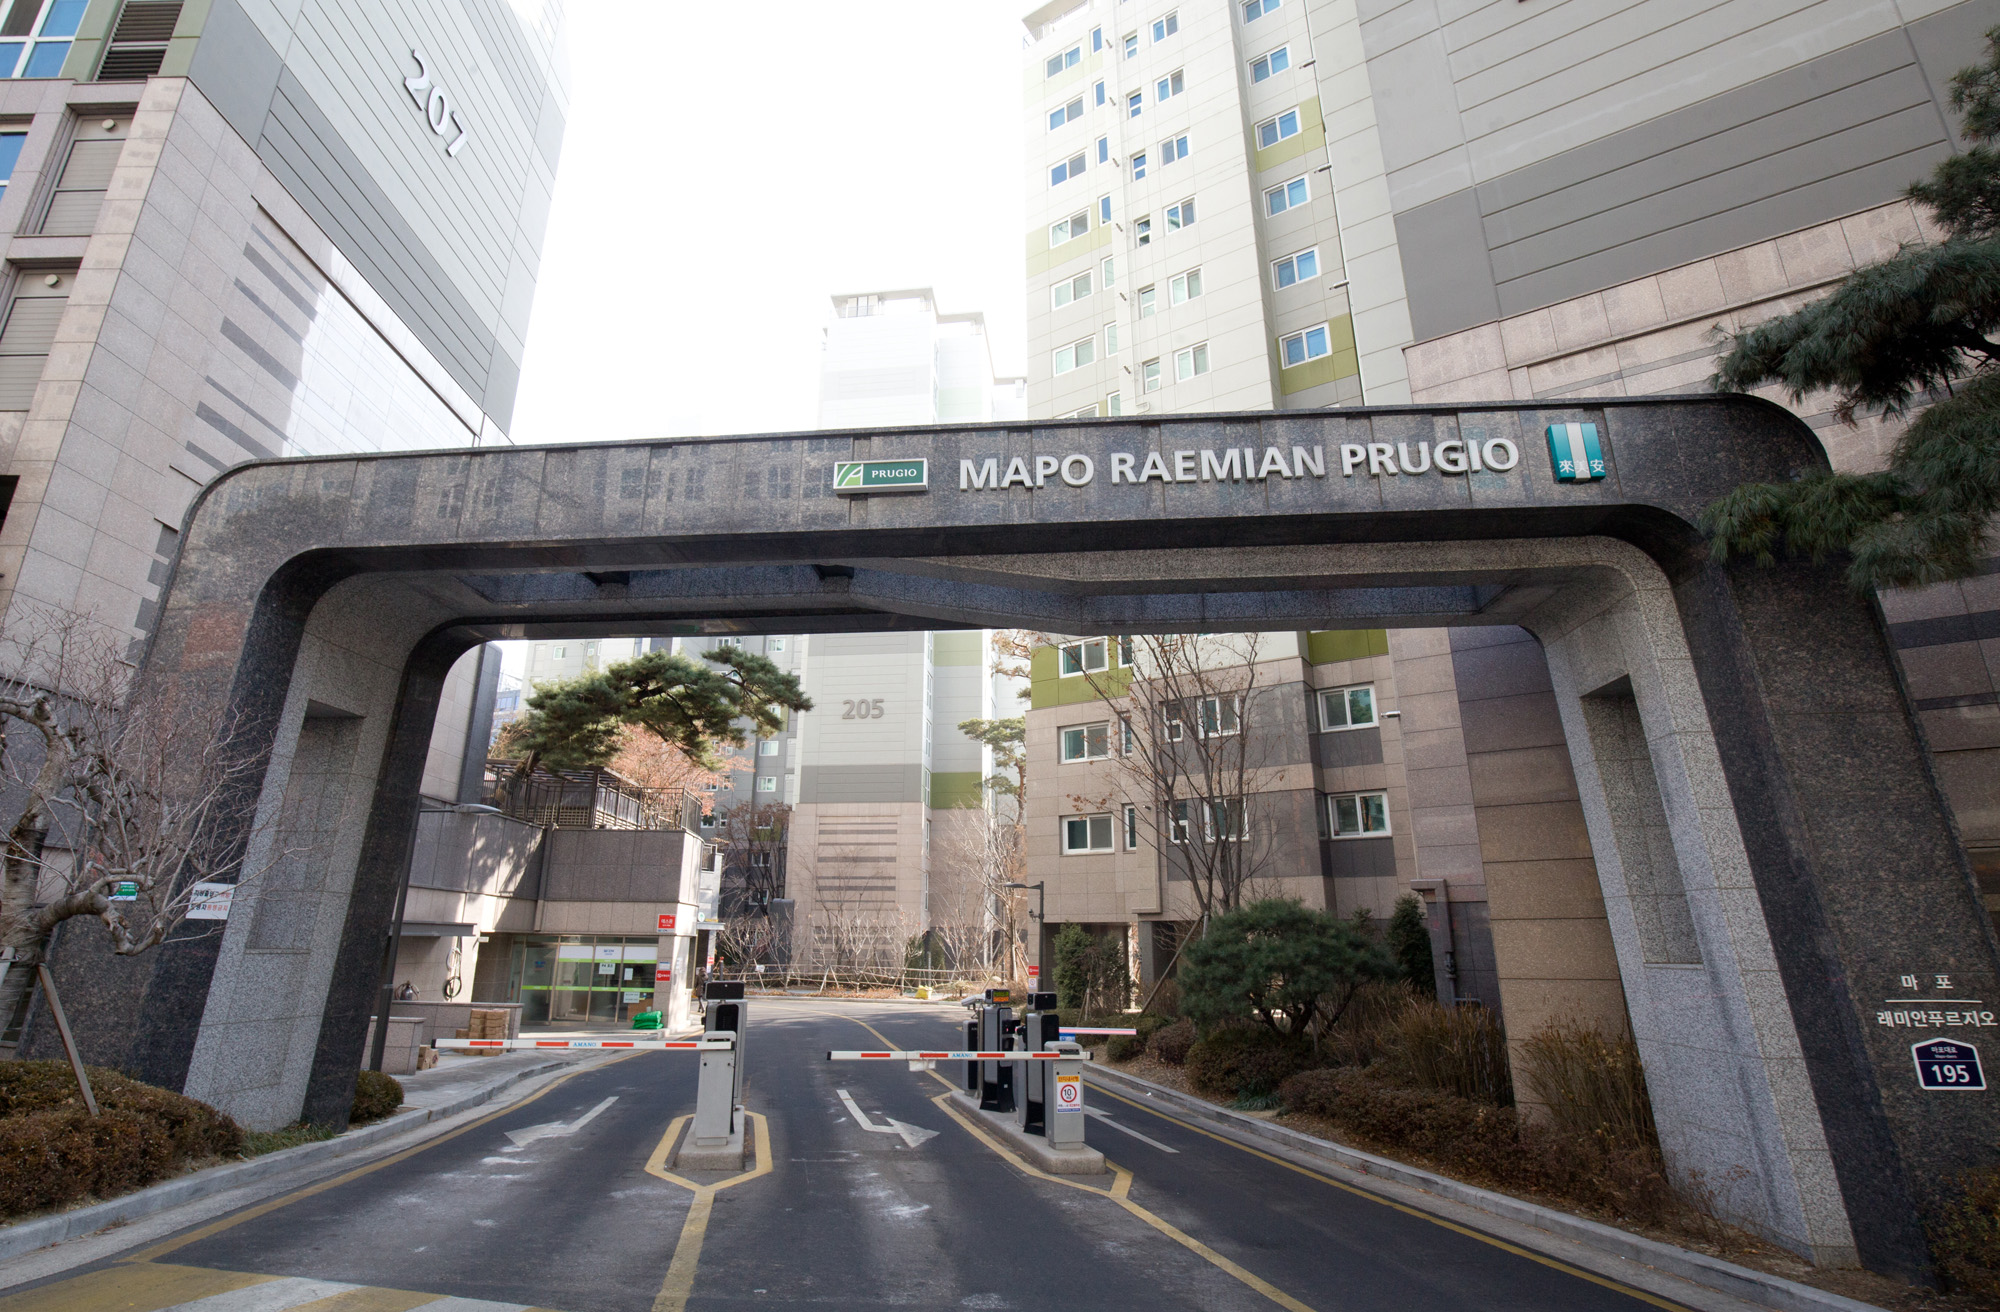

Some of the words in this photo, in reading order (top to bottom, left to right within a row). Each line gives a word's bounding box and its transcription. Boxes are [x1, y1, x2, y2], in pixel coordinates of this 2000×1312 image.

[403, 49, 468, 157] 207
[871, 468, 917, 478] PRUGIO
[958, 453, 1094, 492] MAPO
[1111, 445, 1326, 485] RAEMIAN
[1340, 438, 1520, 478] PRUGIO
[841, 698, 885, 720] 205
[1876, 1010, 1998, 1027] 래미안푸르지오
[1931, 1064, 1970, 1082] 195
[1064, 1088, 1072, 1097] 10
